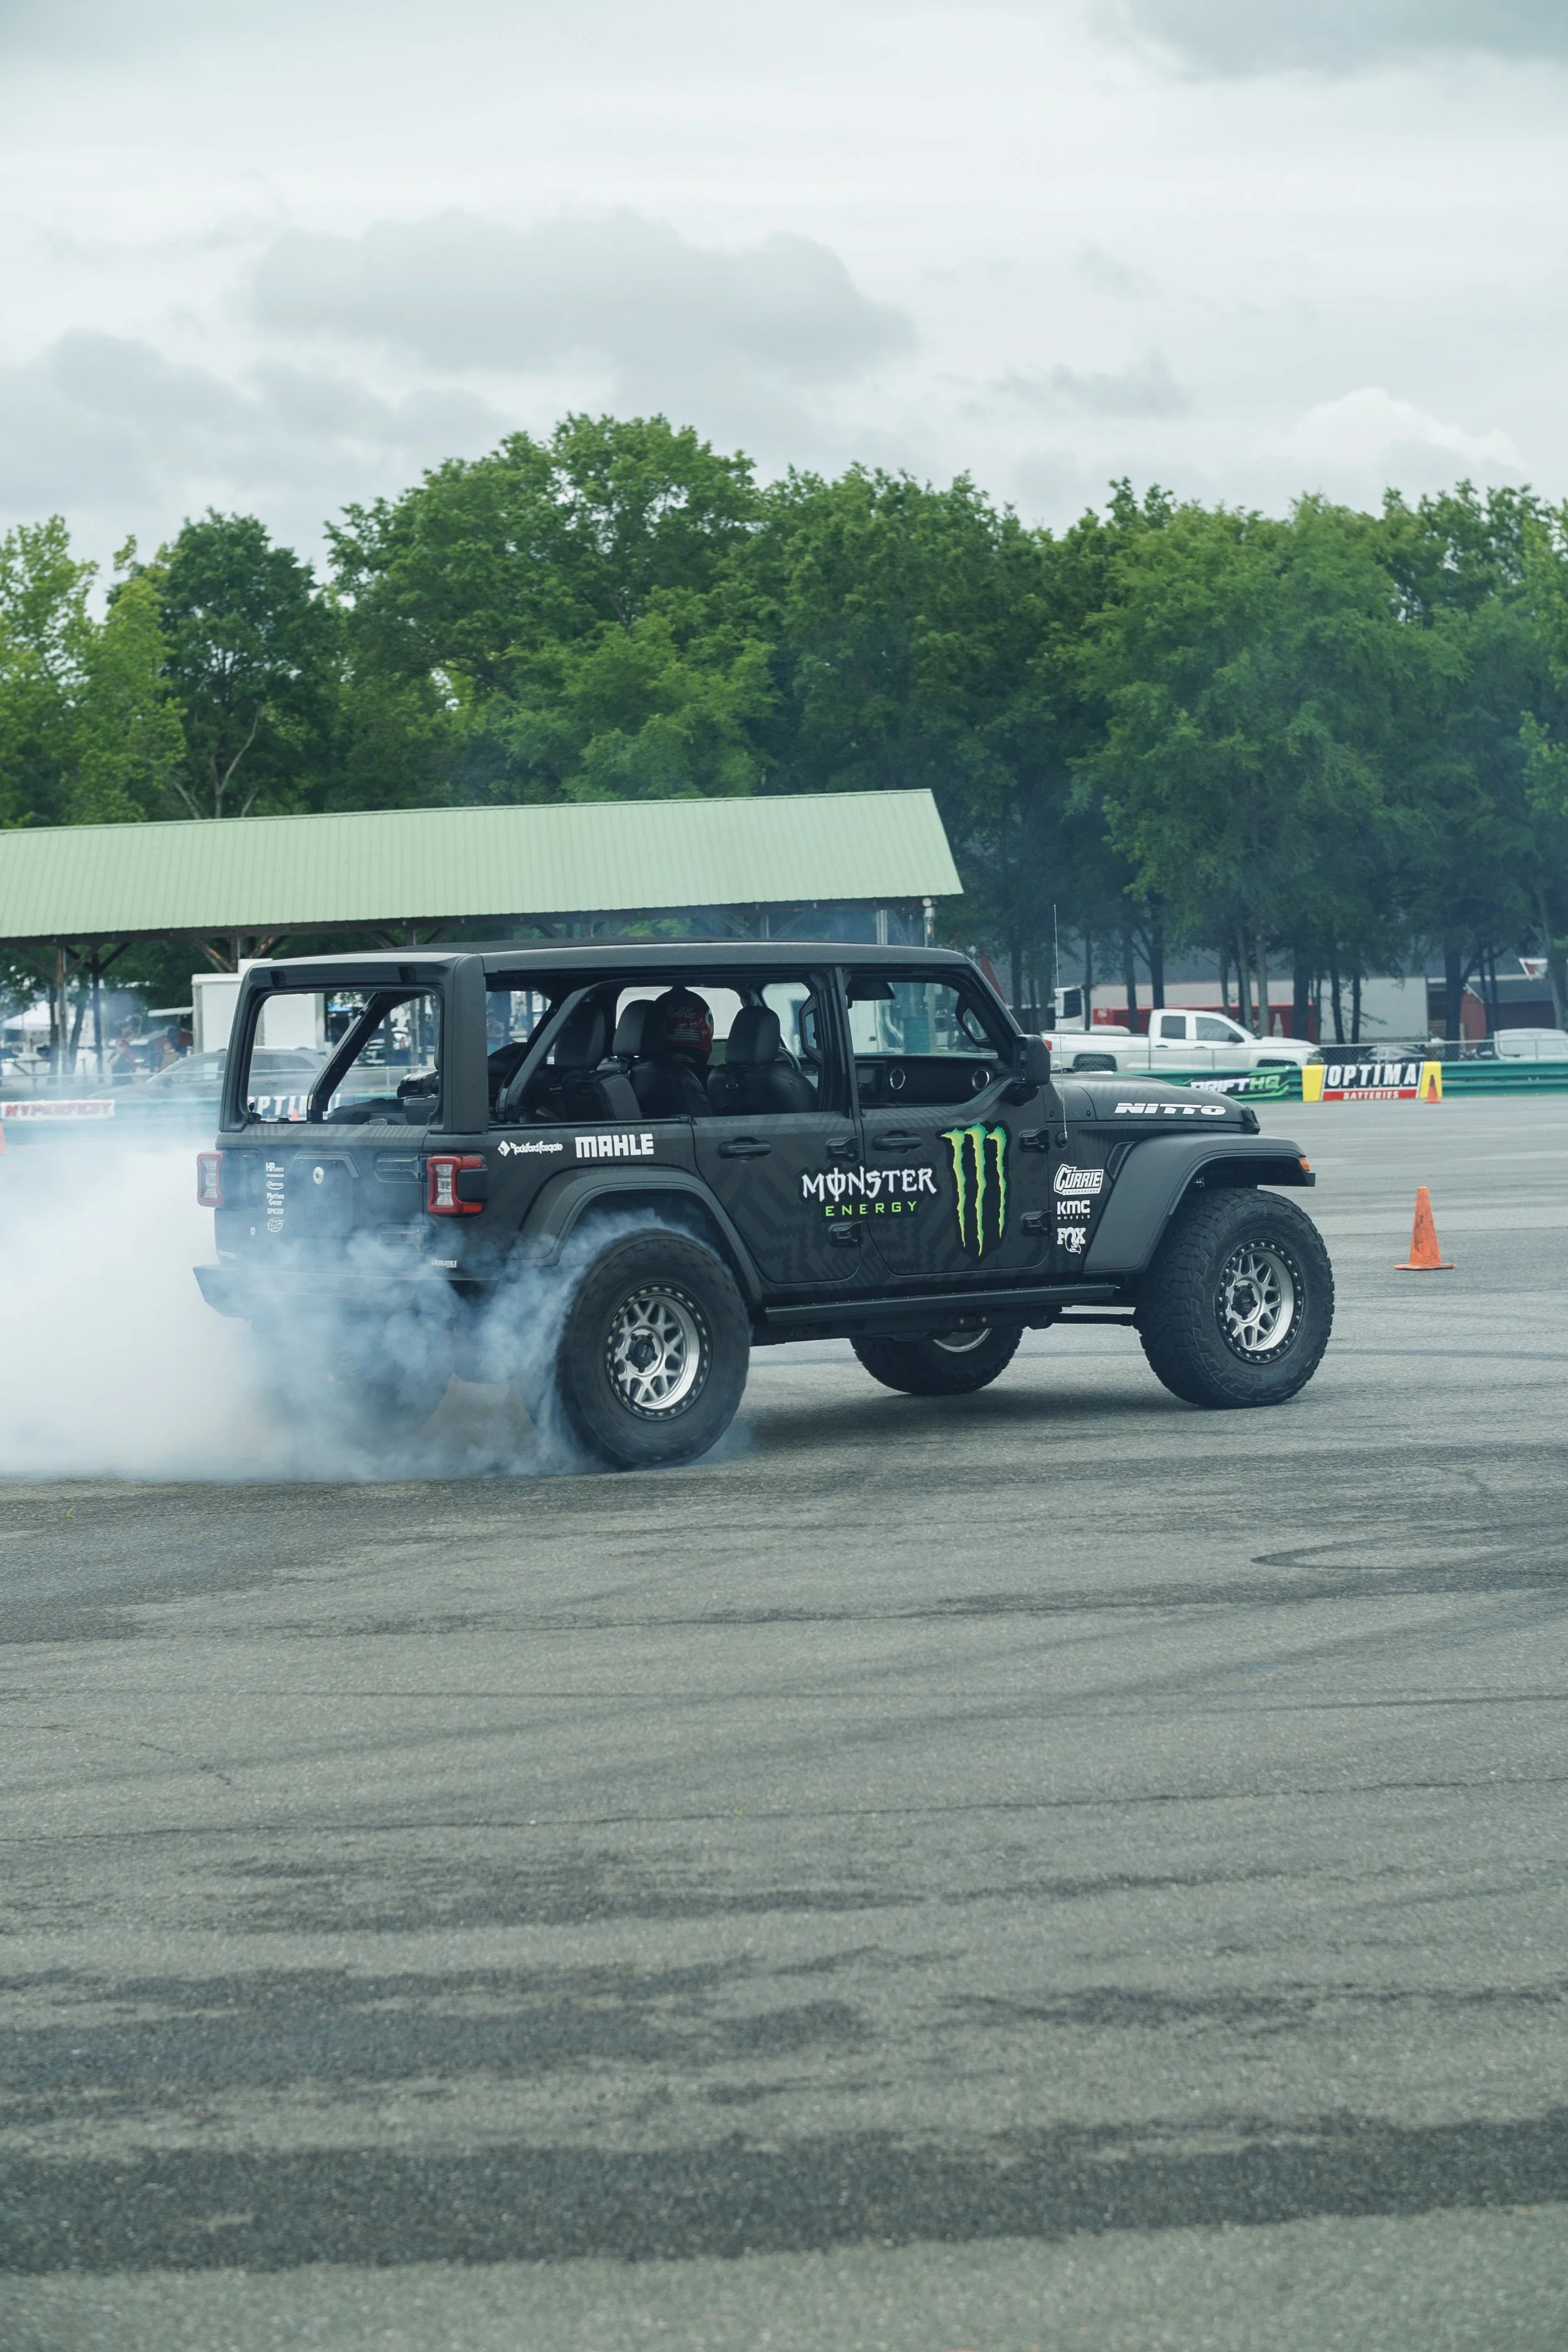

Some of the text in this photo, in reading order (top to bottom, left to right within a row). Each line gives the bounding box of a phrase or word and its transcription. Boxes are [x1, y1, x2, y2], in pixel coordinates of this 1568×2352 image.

[1327, 1063, 1417, 1086] OPTIMA
[1342, 1091, 1400, 1099] BATTERIES
[1114, 1103, 1226, 1116] NITTO
[575, 1133, 654, 1158] MAHLE
[802, 1165, 937, 1202] MONSTER
[1055, 1167, 1102, 1192] CURRIE
[825, 1200, 917, 1217] ENERGY
[1057, 1200, 1091, 1215] KMC
[1057, 1227, 1086, 1251] FOX
